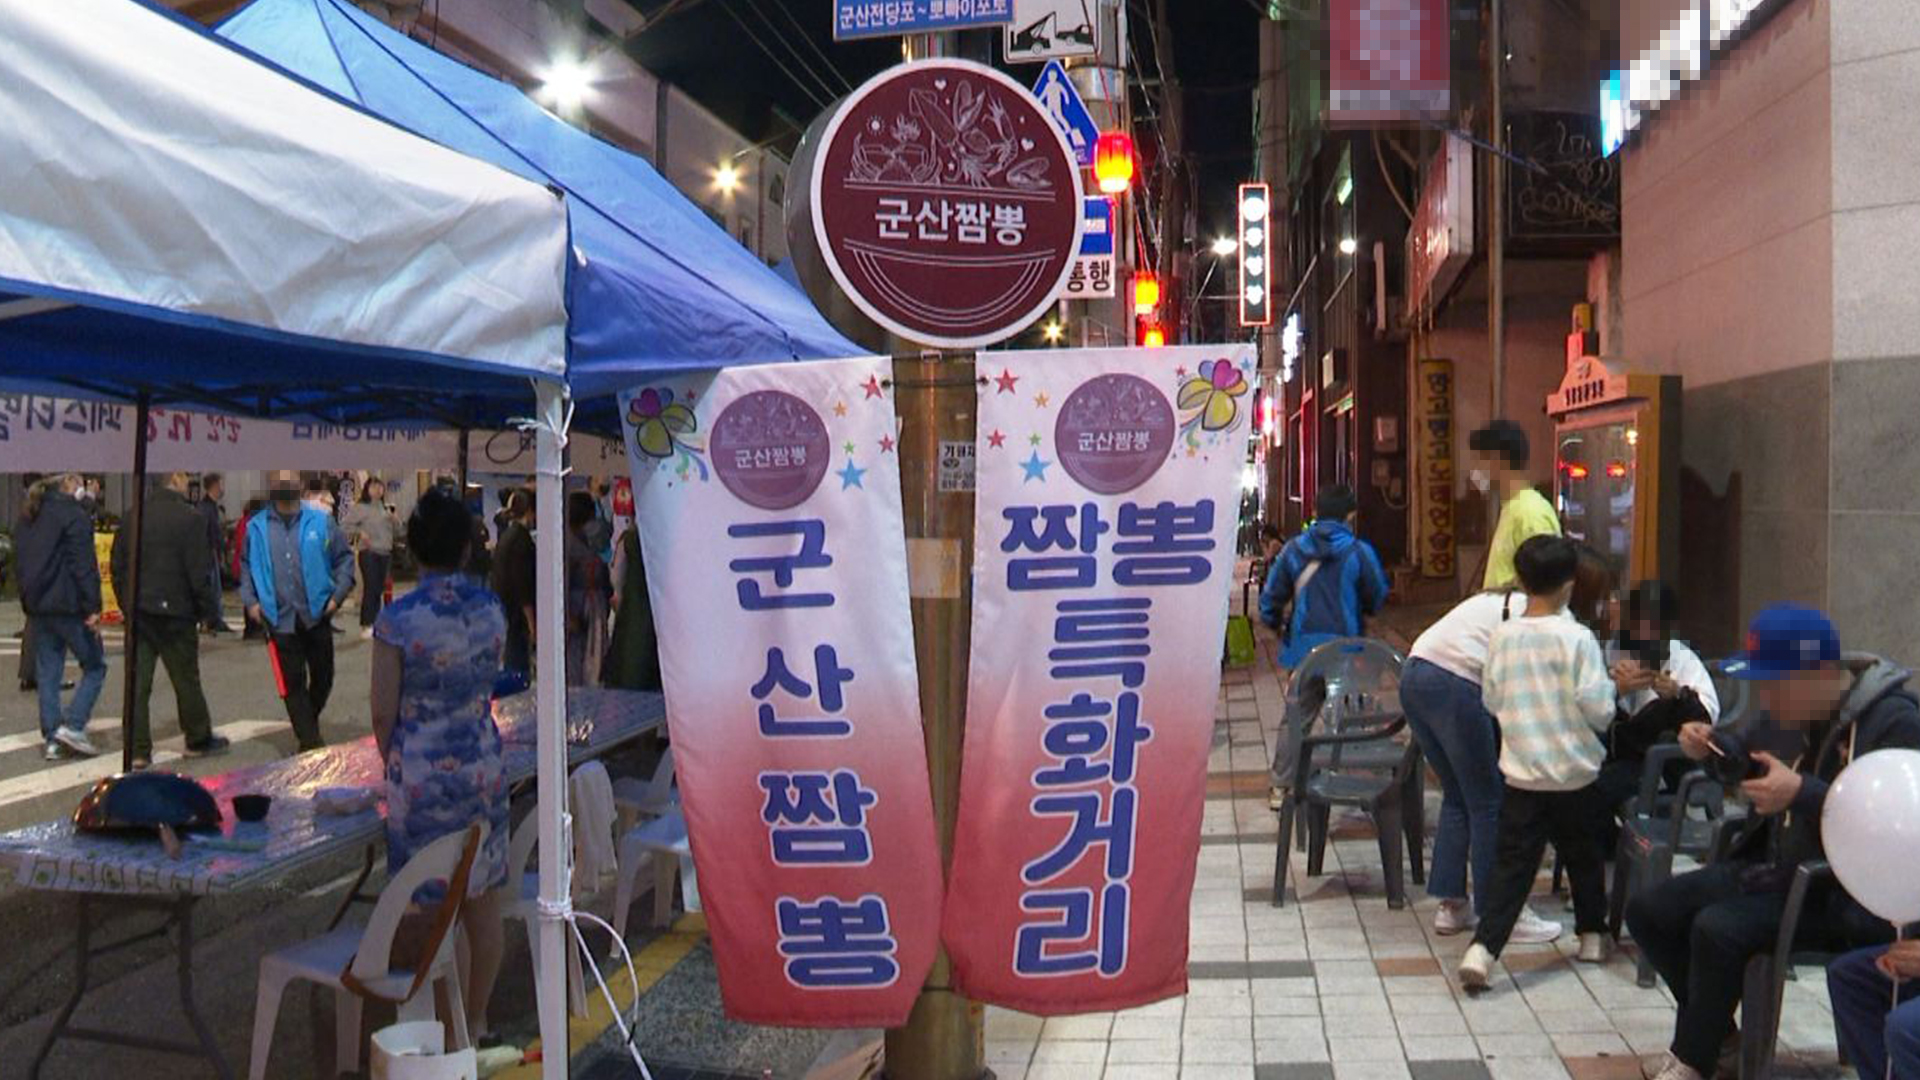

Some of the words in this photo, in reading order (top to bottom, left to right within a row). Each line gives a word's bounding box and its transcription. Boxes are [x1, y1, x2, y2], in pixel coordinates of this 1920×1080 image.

[875, 197, 1027, 246] 군산짬뽕
[735, 445, 807, 469] 군산짬뽕
[1078, 431, 1150, 452] 군산짬뽕
[1000, 498, 1217, 594] 짬뽕
[1012, 597, 1152, 978] 특화거리
